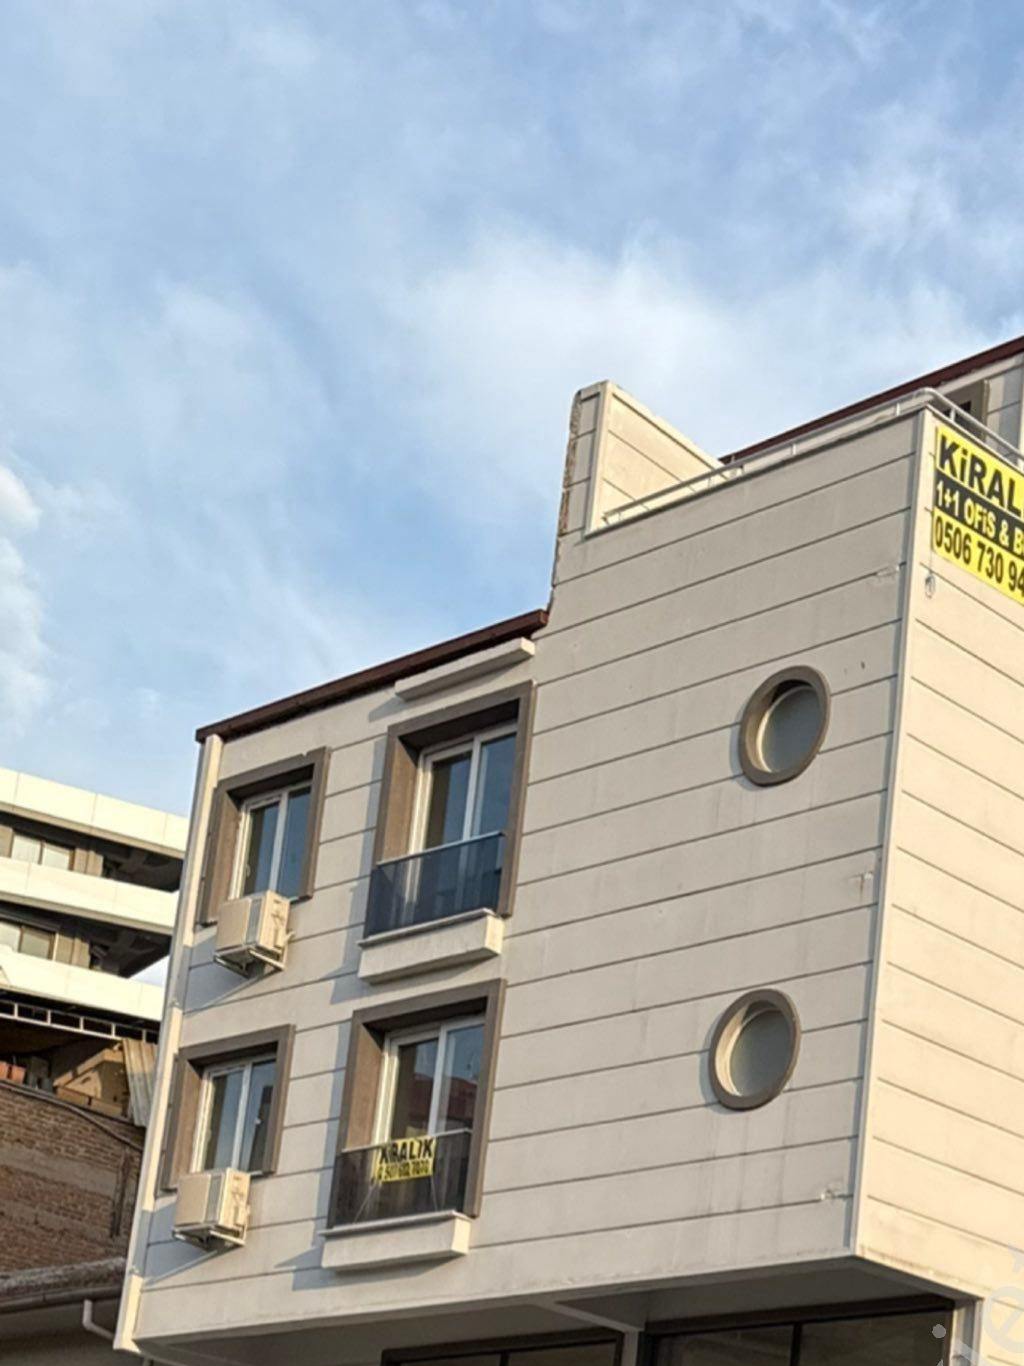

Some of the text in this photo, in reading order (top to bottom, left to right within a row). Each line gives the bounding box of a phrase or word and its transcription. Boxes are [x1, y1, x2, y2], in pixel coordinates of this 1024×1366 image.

[936, 480, 960, 517] 1+1
[935, 515, 972, 566] 0506
[977, 542, 1004, 584] 730
